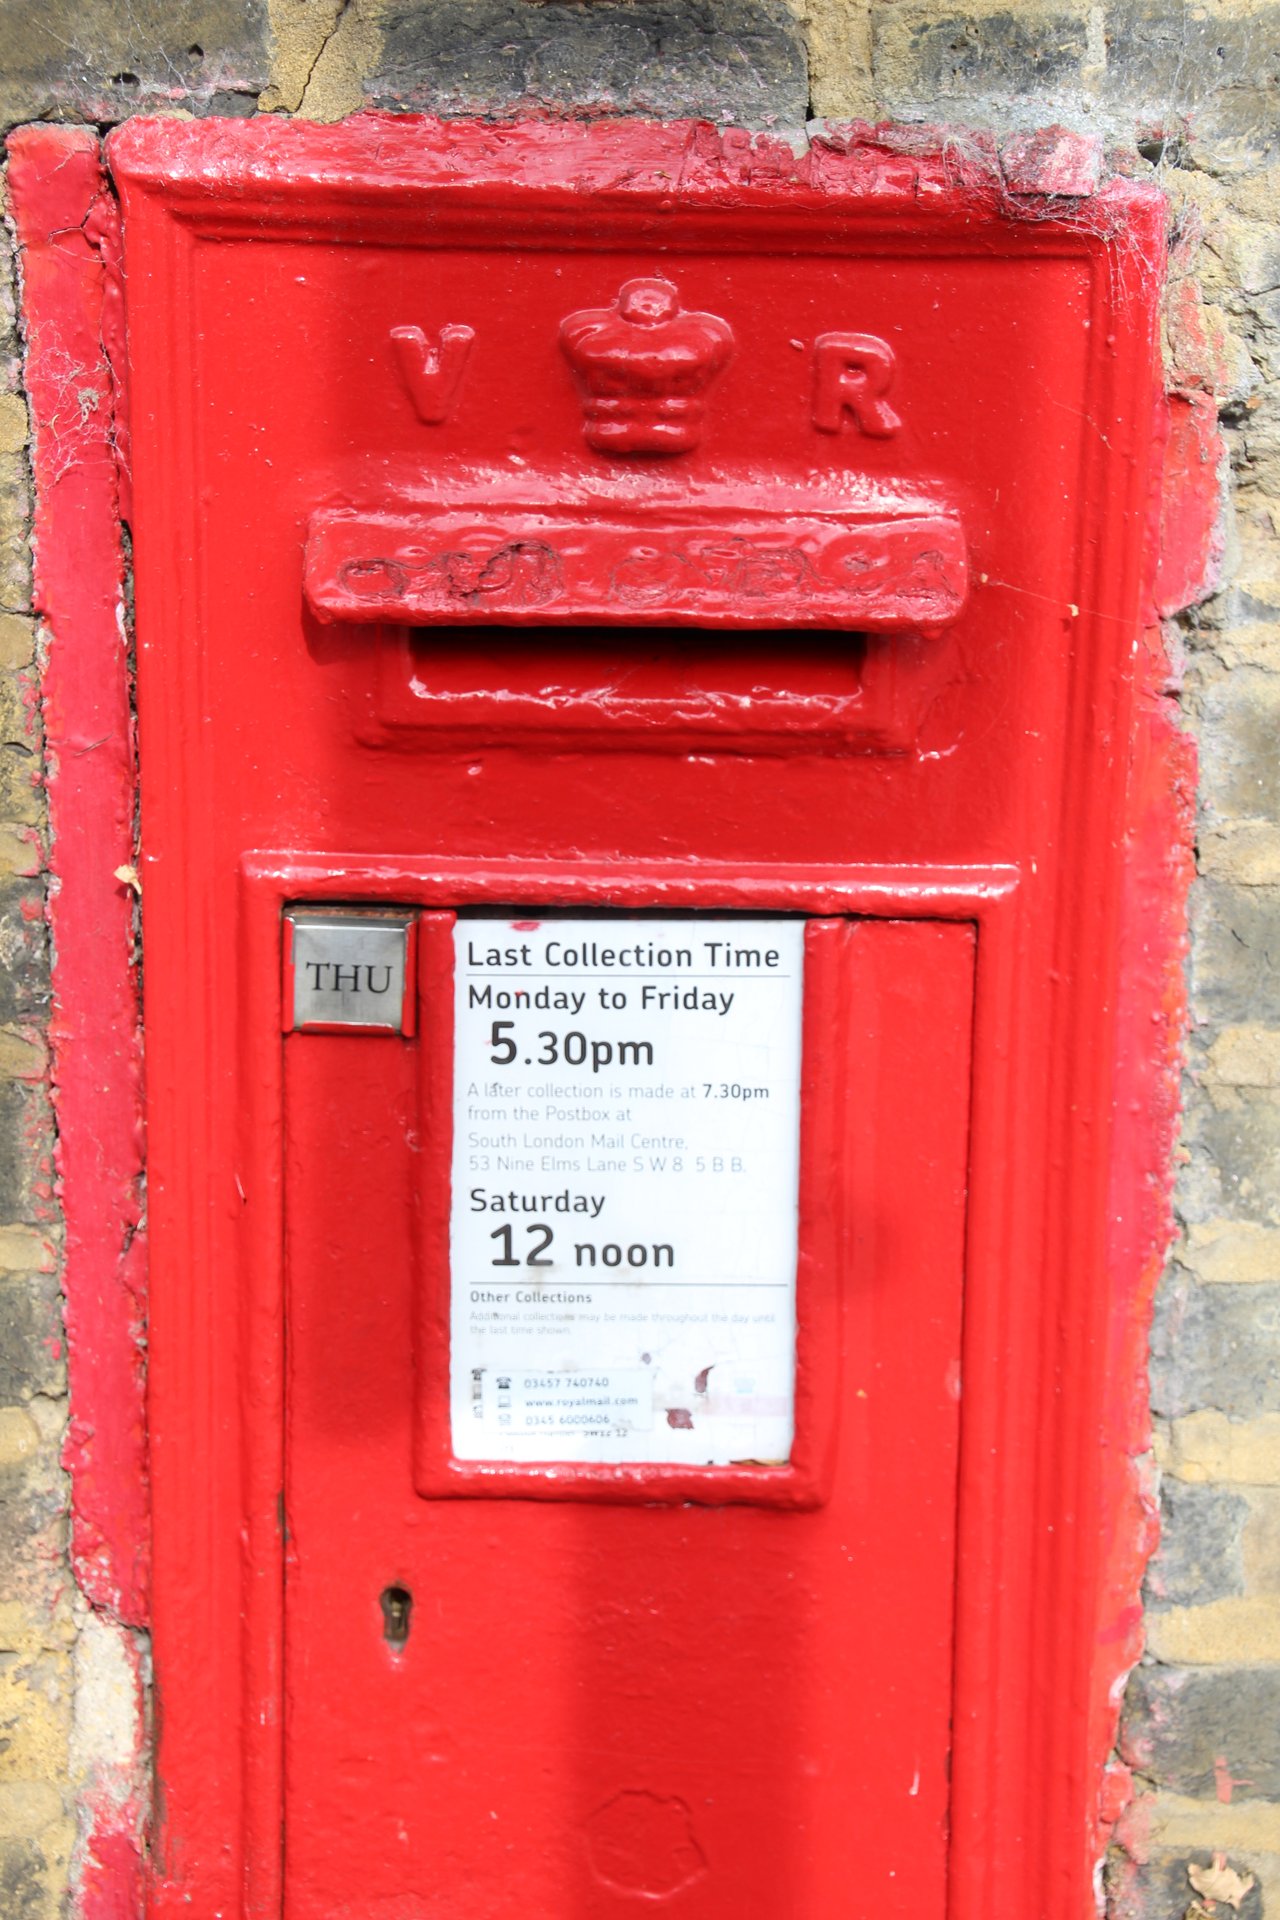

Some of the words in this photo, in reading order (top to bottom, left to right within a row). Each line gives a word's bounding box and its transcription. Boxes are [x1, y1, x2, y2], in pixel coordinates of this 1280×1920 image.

[389, 324, 476, 425] V
[812, 331, 903, 439] R
[468, 942, 532, 967] Last
[545, 942, 692, 967] Collection
[704, 943, 780, 968] Time
[306, 961, 393, 994] THU
[468, 985, 586, 1015] Monday
[598, 988, 627, 1010] to
[642, 986, 735, 1015] Friday
[490, 1021, 654, 1073] 5.30pm
[467, 1082, 480, 1098] A
[484, 1081, 522, 1099] later
[526, 1083, 604, 1099] collection
[609, 1083, 623, 1099] is
[628, 1083, 675, 1099] made
[680, 1084, 696, 1099] at
[702, 1083, 770, 1102] 7.30pm
[467, 1105, 508, 1121] from
[513, 1105, 540, 1121] the
[545, 1105, 611, 1121] Postbox
[615, 1107, 632, 1121] at
[468, 1133, 517, 1149] South
[523, 1132, 585, 1149] London
[591, 1133, 625, 1149] Mail
[469, 1156, 490, 1171] 53
[497, 1156, 535, 1171] Nine
[540, 1156, 581, 1171] Elms
[587, 1156, 627, 1172] Lane
[470, 1188, 605, 1218] Saturday
[490, 1223, 555, 1267] 12
[575, 1243, 674, 1267] noon
[469, 1290, 510, 1303] Other
[515, 1290, 593, 1304] Collections
[578, 1313, 600, 1324] may
[603, 1312, 616, 1322] be
[619, 1312, 649, 1322] made
[651, 1312, 708, 1324] throughout
[711, 1312, 728, 1323] the
[731, 1312, 749, 1325] day
[752, 1312, 776, 1323] until
[469, 1325, 487, 1335] the
[489, 1325, 508, 1335] last
[510, 1325, 533, 1335] time
[523, 1378, 561, 1389] 03457
[565, 1377, 610, 1388] 740740
[525, 1396, 639, 1409] www.royalmail.com
[525, 1416, 555, 1426] 0345
[559, 1415, 611, 1425] 6000606
